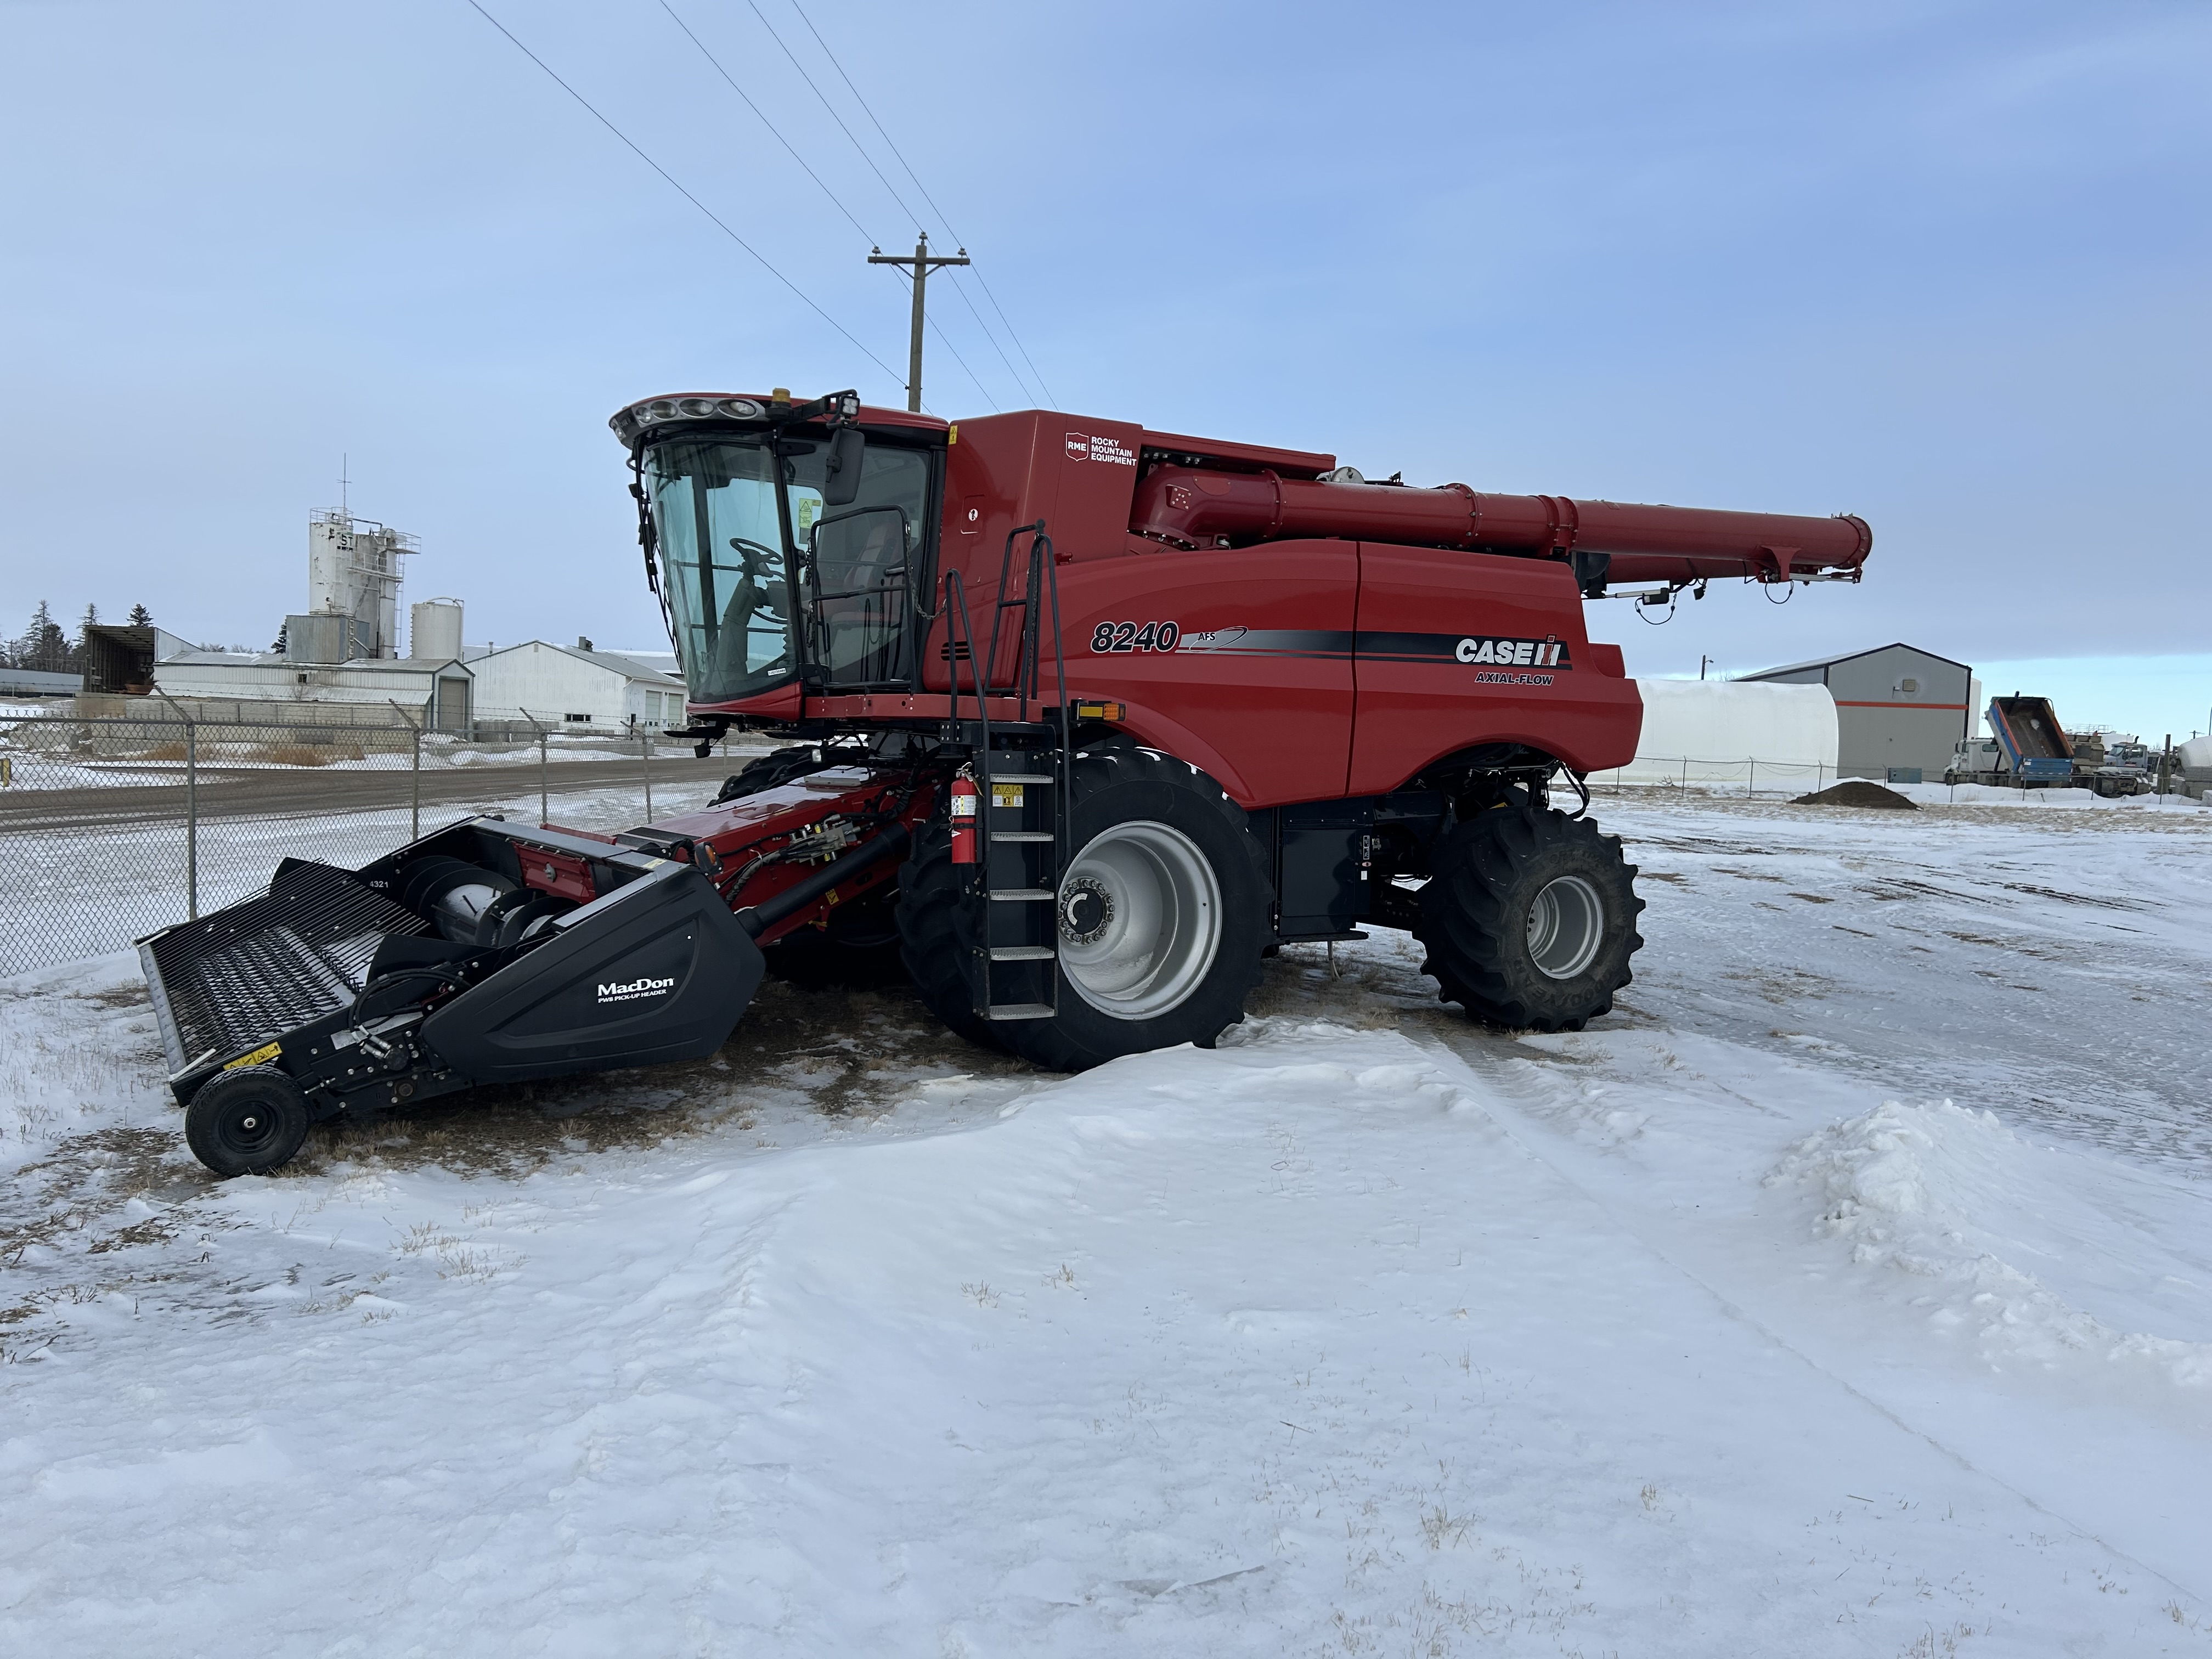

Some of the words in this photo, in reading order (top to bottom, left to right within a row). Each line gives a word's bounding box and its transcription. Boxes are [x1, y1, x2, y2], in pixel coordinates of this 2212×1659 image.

[1068, 441, 1087, 452] RME
[1091, 436, 1120, 448] ROCKY
[1091, 444, 1132, 458] MOUNTAIN
[1091, 453, 1137, 466] EQUIPMENT
[1090, 620, 1180, 653] 8240
[1198, 632, 1216, 641] AFS
[1455, 638, 1534, 665] CASE
[1474, 672, 1554, 686] AXIAL-FLOW
[597, 978, 674, 996] MacDon
[614, 993, 640, 1001] PICK-UP
